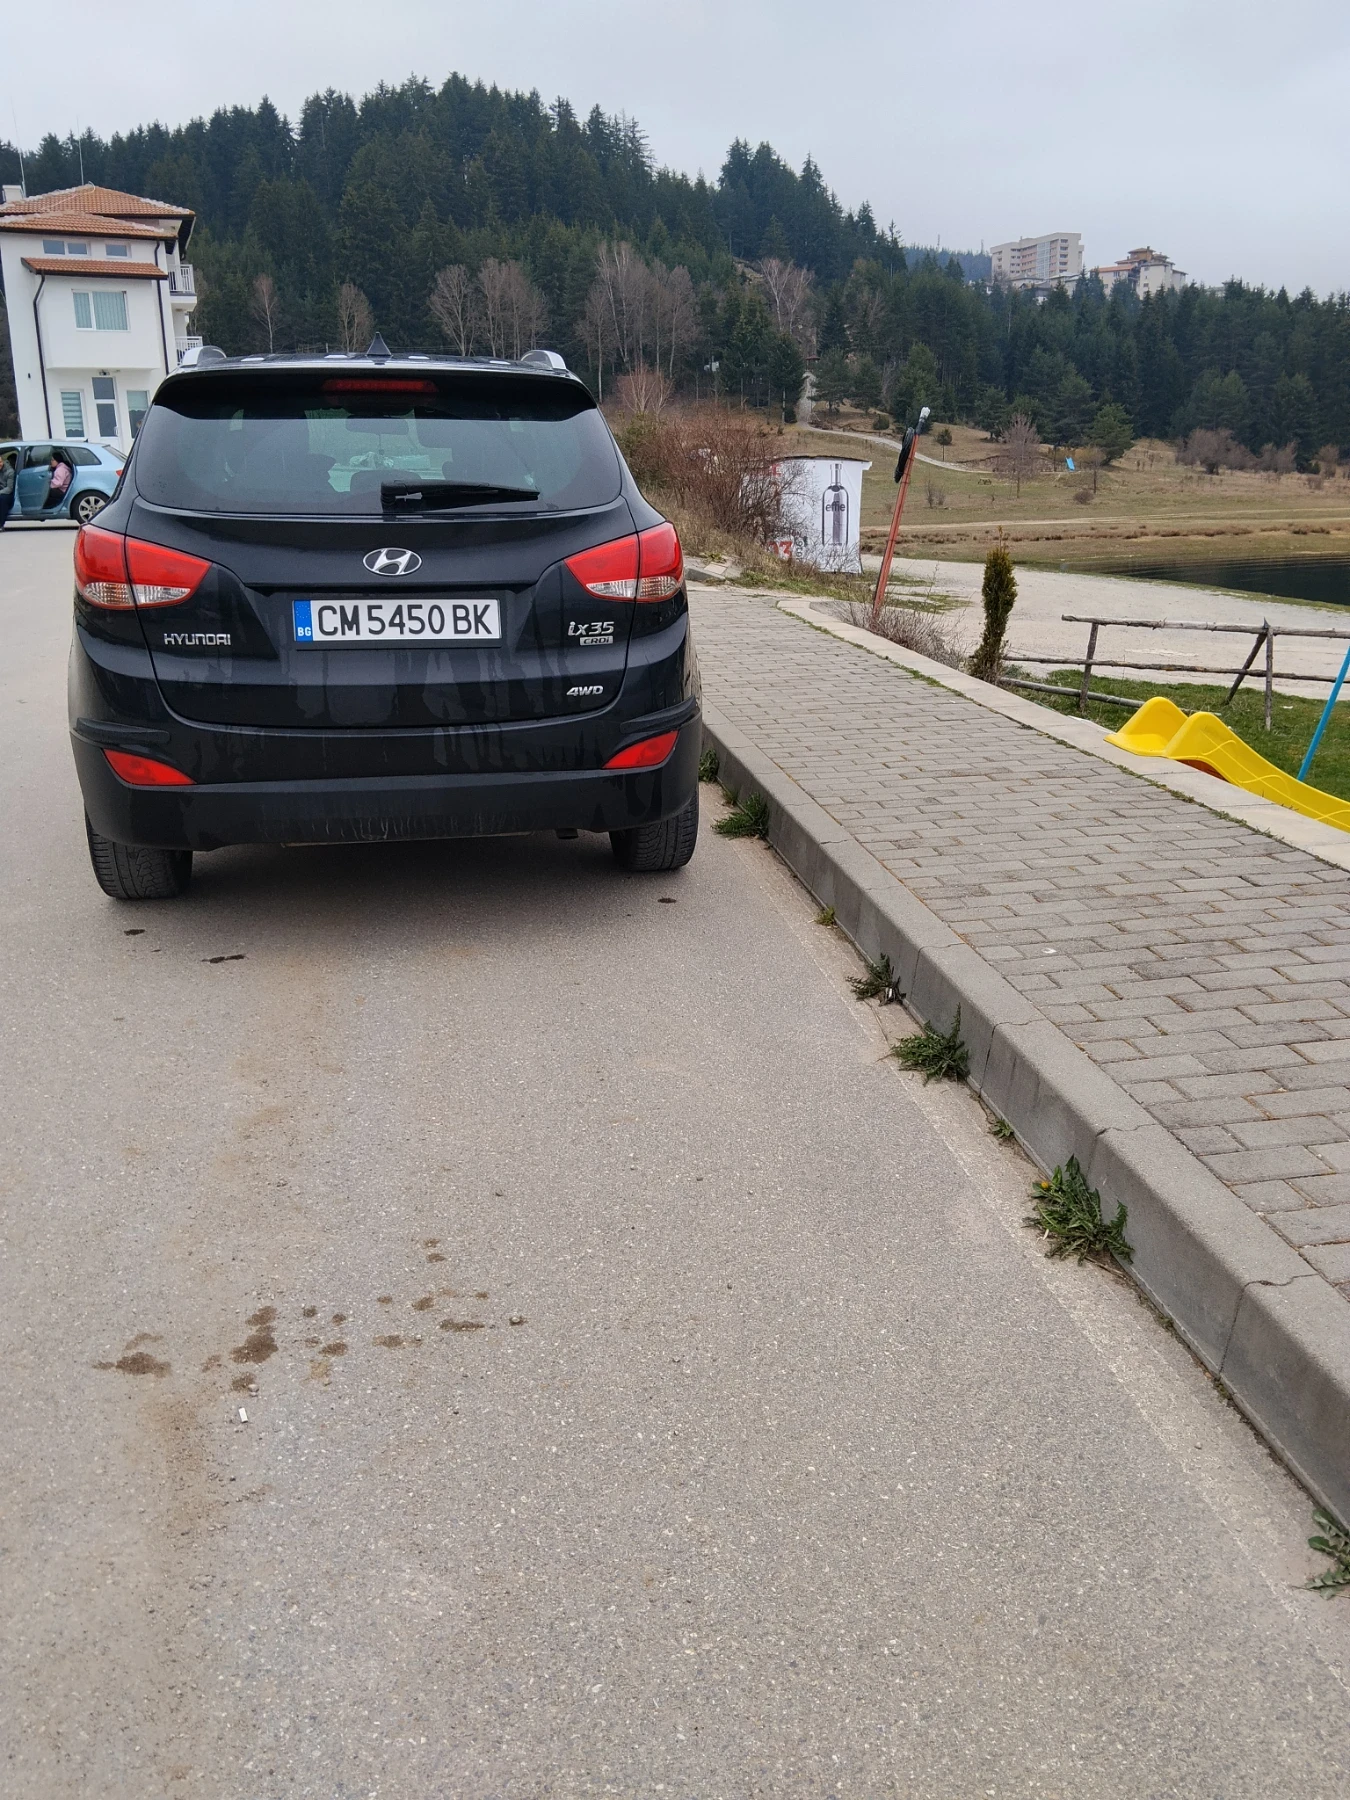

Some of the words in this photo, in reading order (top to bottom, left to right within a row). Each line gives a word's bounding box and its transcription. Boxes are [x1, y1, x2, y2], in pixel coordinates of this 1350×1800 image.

[825, 501, 846, 512] effie
[318, 605, 361, 636] CM
[367, 604, 445, 635] 5450
[452, 604, 492, 635] BK
[297, 627, 312, 637] BG
[567, 621, 615, 636] ix35
[164, 633, 231, 646] HYUNDAI
[566, 685, 604, 697] 4WD
